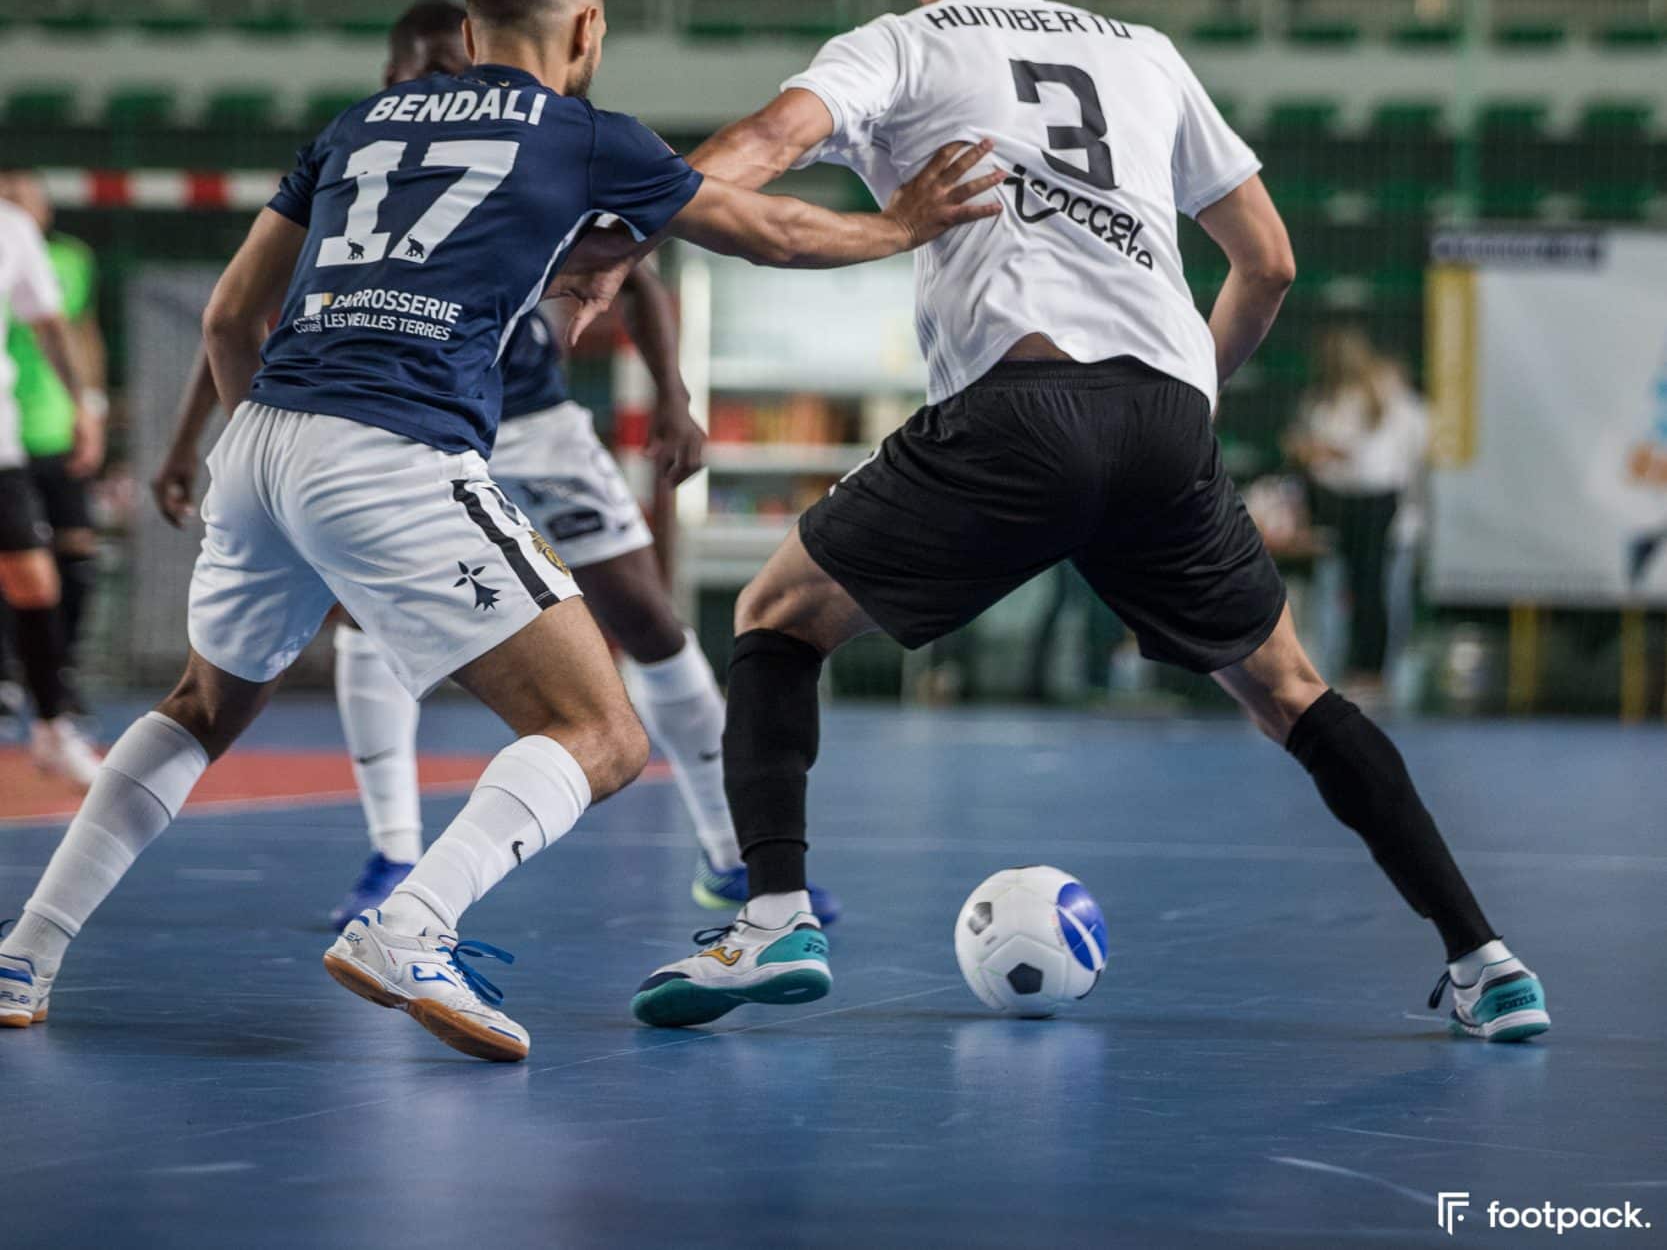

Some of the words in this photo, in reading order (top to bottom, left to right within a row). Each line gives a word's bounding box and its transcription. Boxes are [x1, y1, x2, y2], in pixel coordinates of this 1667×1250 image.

[364, 87, 548, 126] BENDALI
[1008, 57, 1121, 191] 3
[315, 139, 521, 268] 17
[329, 288, 463, 325] CARROSSERIE
[324, 312, 346, 328] LES
[399, 317, 452, 341] TERRES
